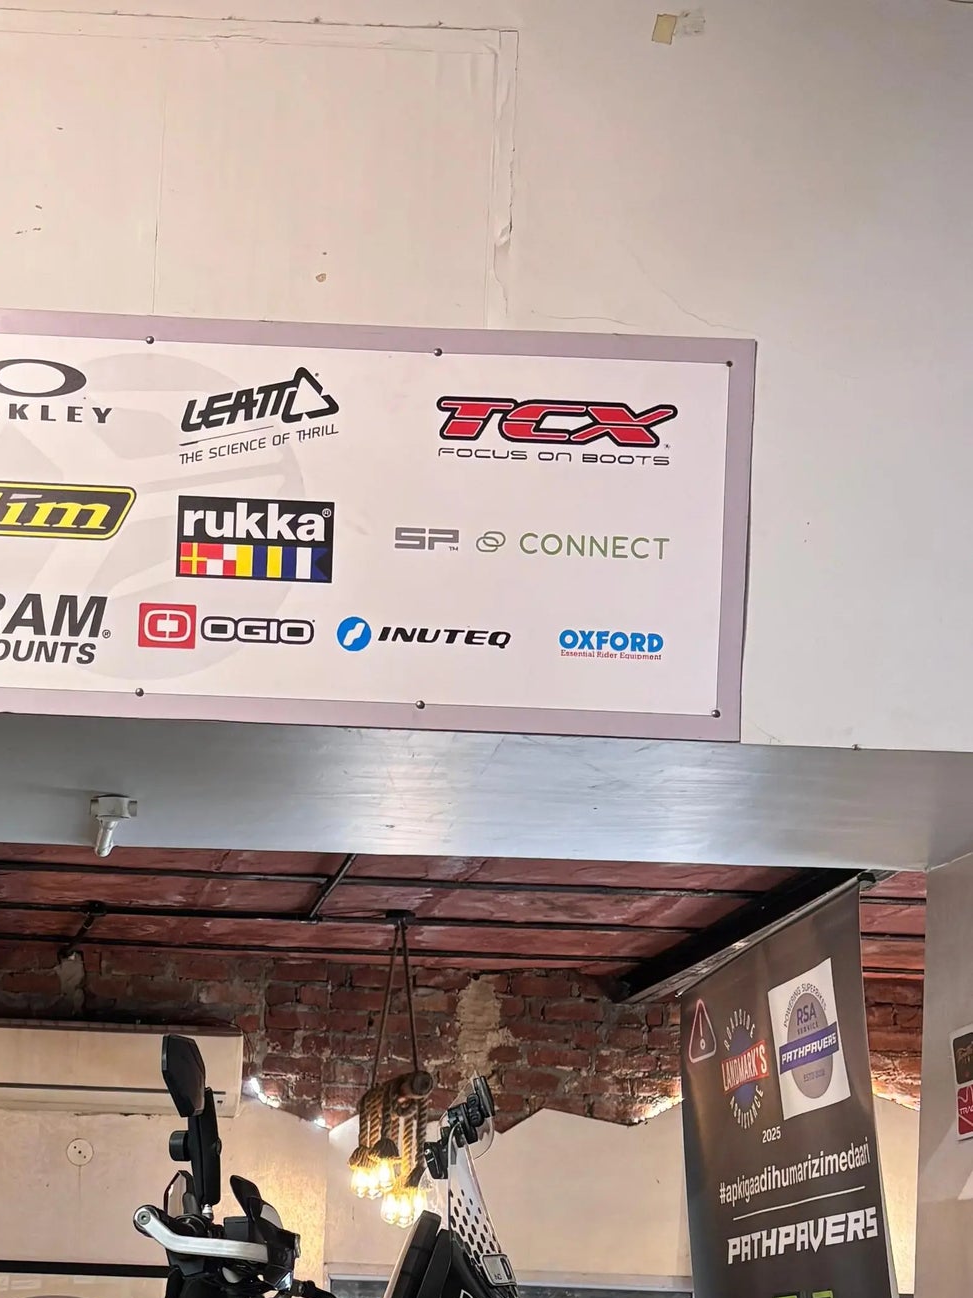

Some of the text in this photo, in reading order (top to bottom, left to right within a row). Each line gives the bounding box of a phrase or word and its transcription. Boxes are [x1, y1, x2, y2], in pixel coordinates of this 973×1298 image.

[436, 396, 678, 448] TCX
[179, 423, 339, 465] THE SCIENCE OF THRILL
[438, 447, 670, 466] FOCUS ON BOOTS
[183, 502, 325, 542] rukka
[394, 527, 670, 561] SP CONNECT
[201, 616, 315, 645] OGIO
[377, 625, 512, 650] INUTEQ
[558, 628, 664, 653] OXFORD
[560, 649, 662, 661] Essential Rider Equipment
[724, 1008, 756, 1051] ROADSIDE
[796, 1002, 817, 1027] RSA
[781, 1032, 837, 1065] PATHPAVERS
[722, 1044, 767, 1091] LANDMARK'S
[762, 1126, 782, 1144] 2025
[727, 1206, 878, 1265] PATHPAVERS
